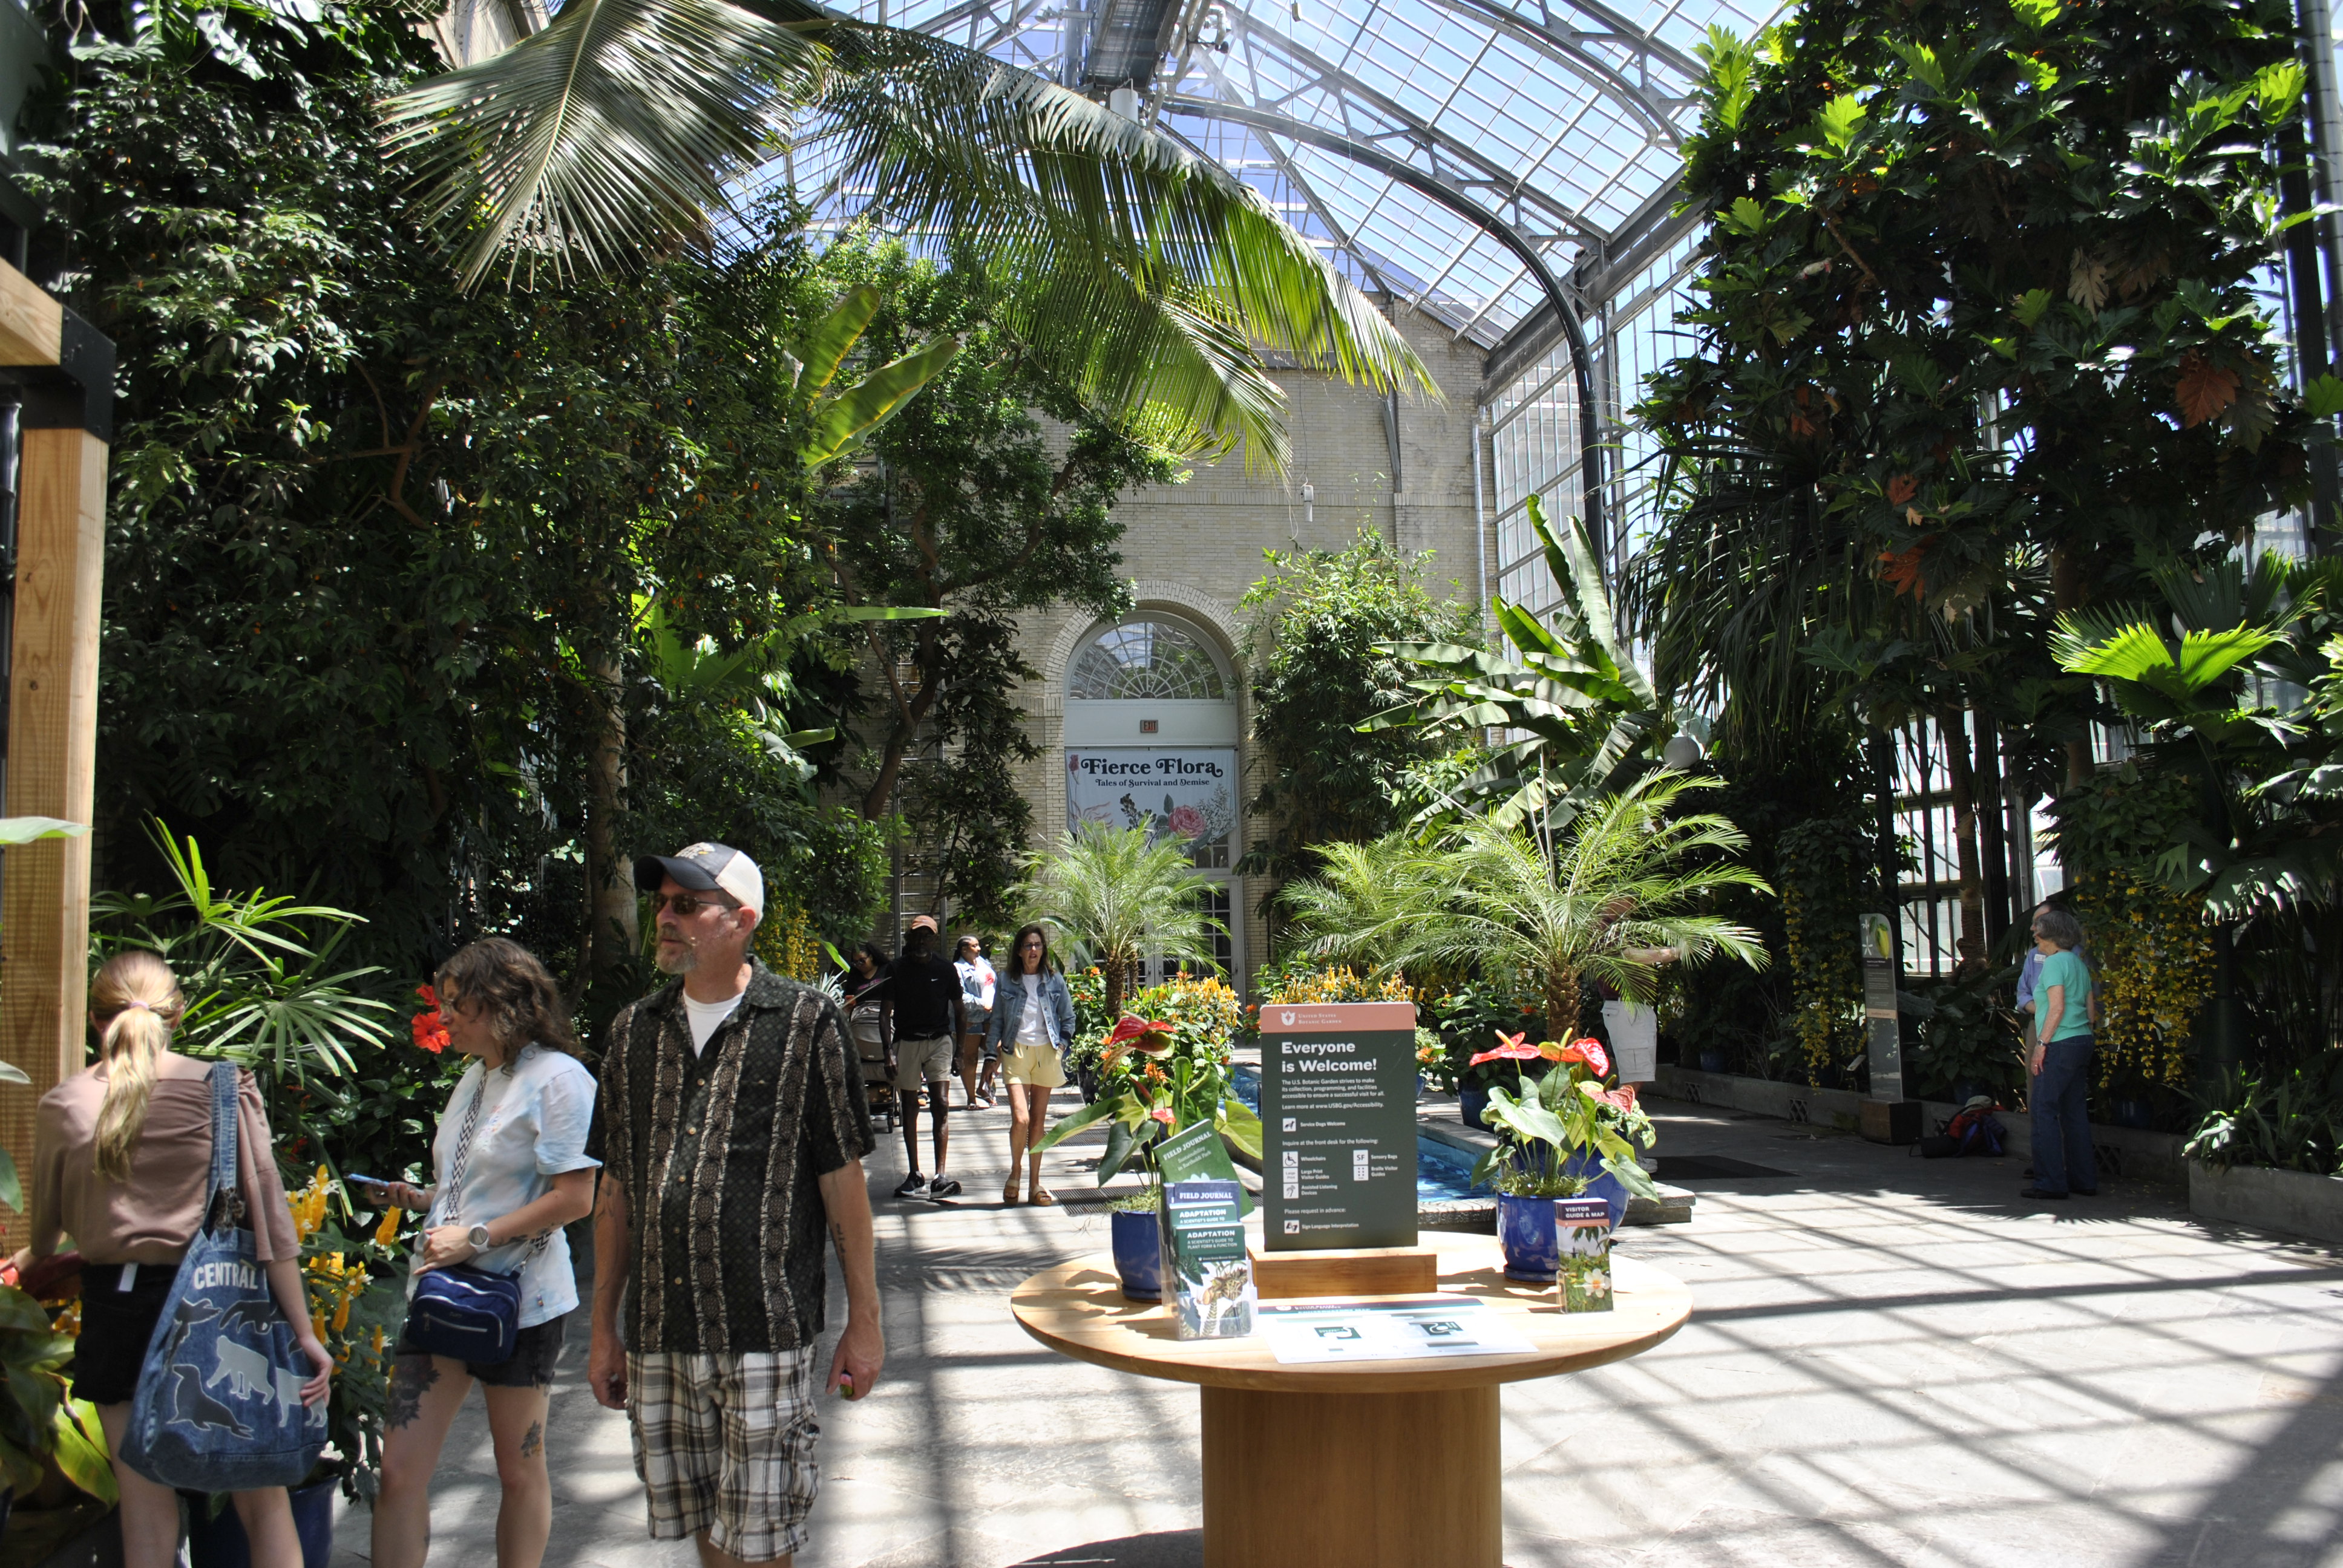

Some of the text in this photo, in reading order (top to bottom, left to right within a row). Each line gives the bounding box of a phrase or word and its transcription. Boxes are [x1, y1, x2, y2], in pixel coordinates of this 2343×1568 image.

[1143, 720, 1156, 731] EXIT
[1081, 758, 1224, 777] Fierce Flora
[1129, 779, 1161, 788] Survival
[1281, 1041, 1356, 1056] Everyone
[1282, 1058, 1377, 1073] is Welcome!
[1163, 1131, 1212, 1161] FIELD JOURNAL
[1179, 1209, 1227, 1218] ADAPTATION
[1187, 1230, 1235, 1239] ADAPTATION
[194, 1262, 258, 1290] CENTRAL
